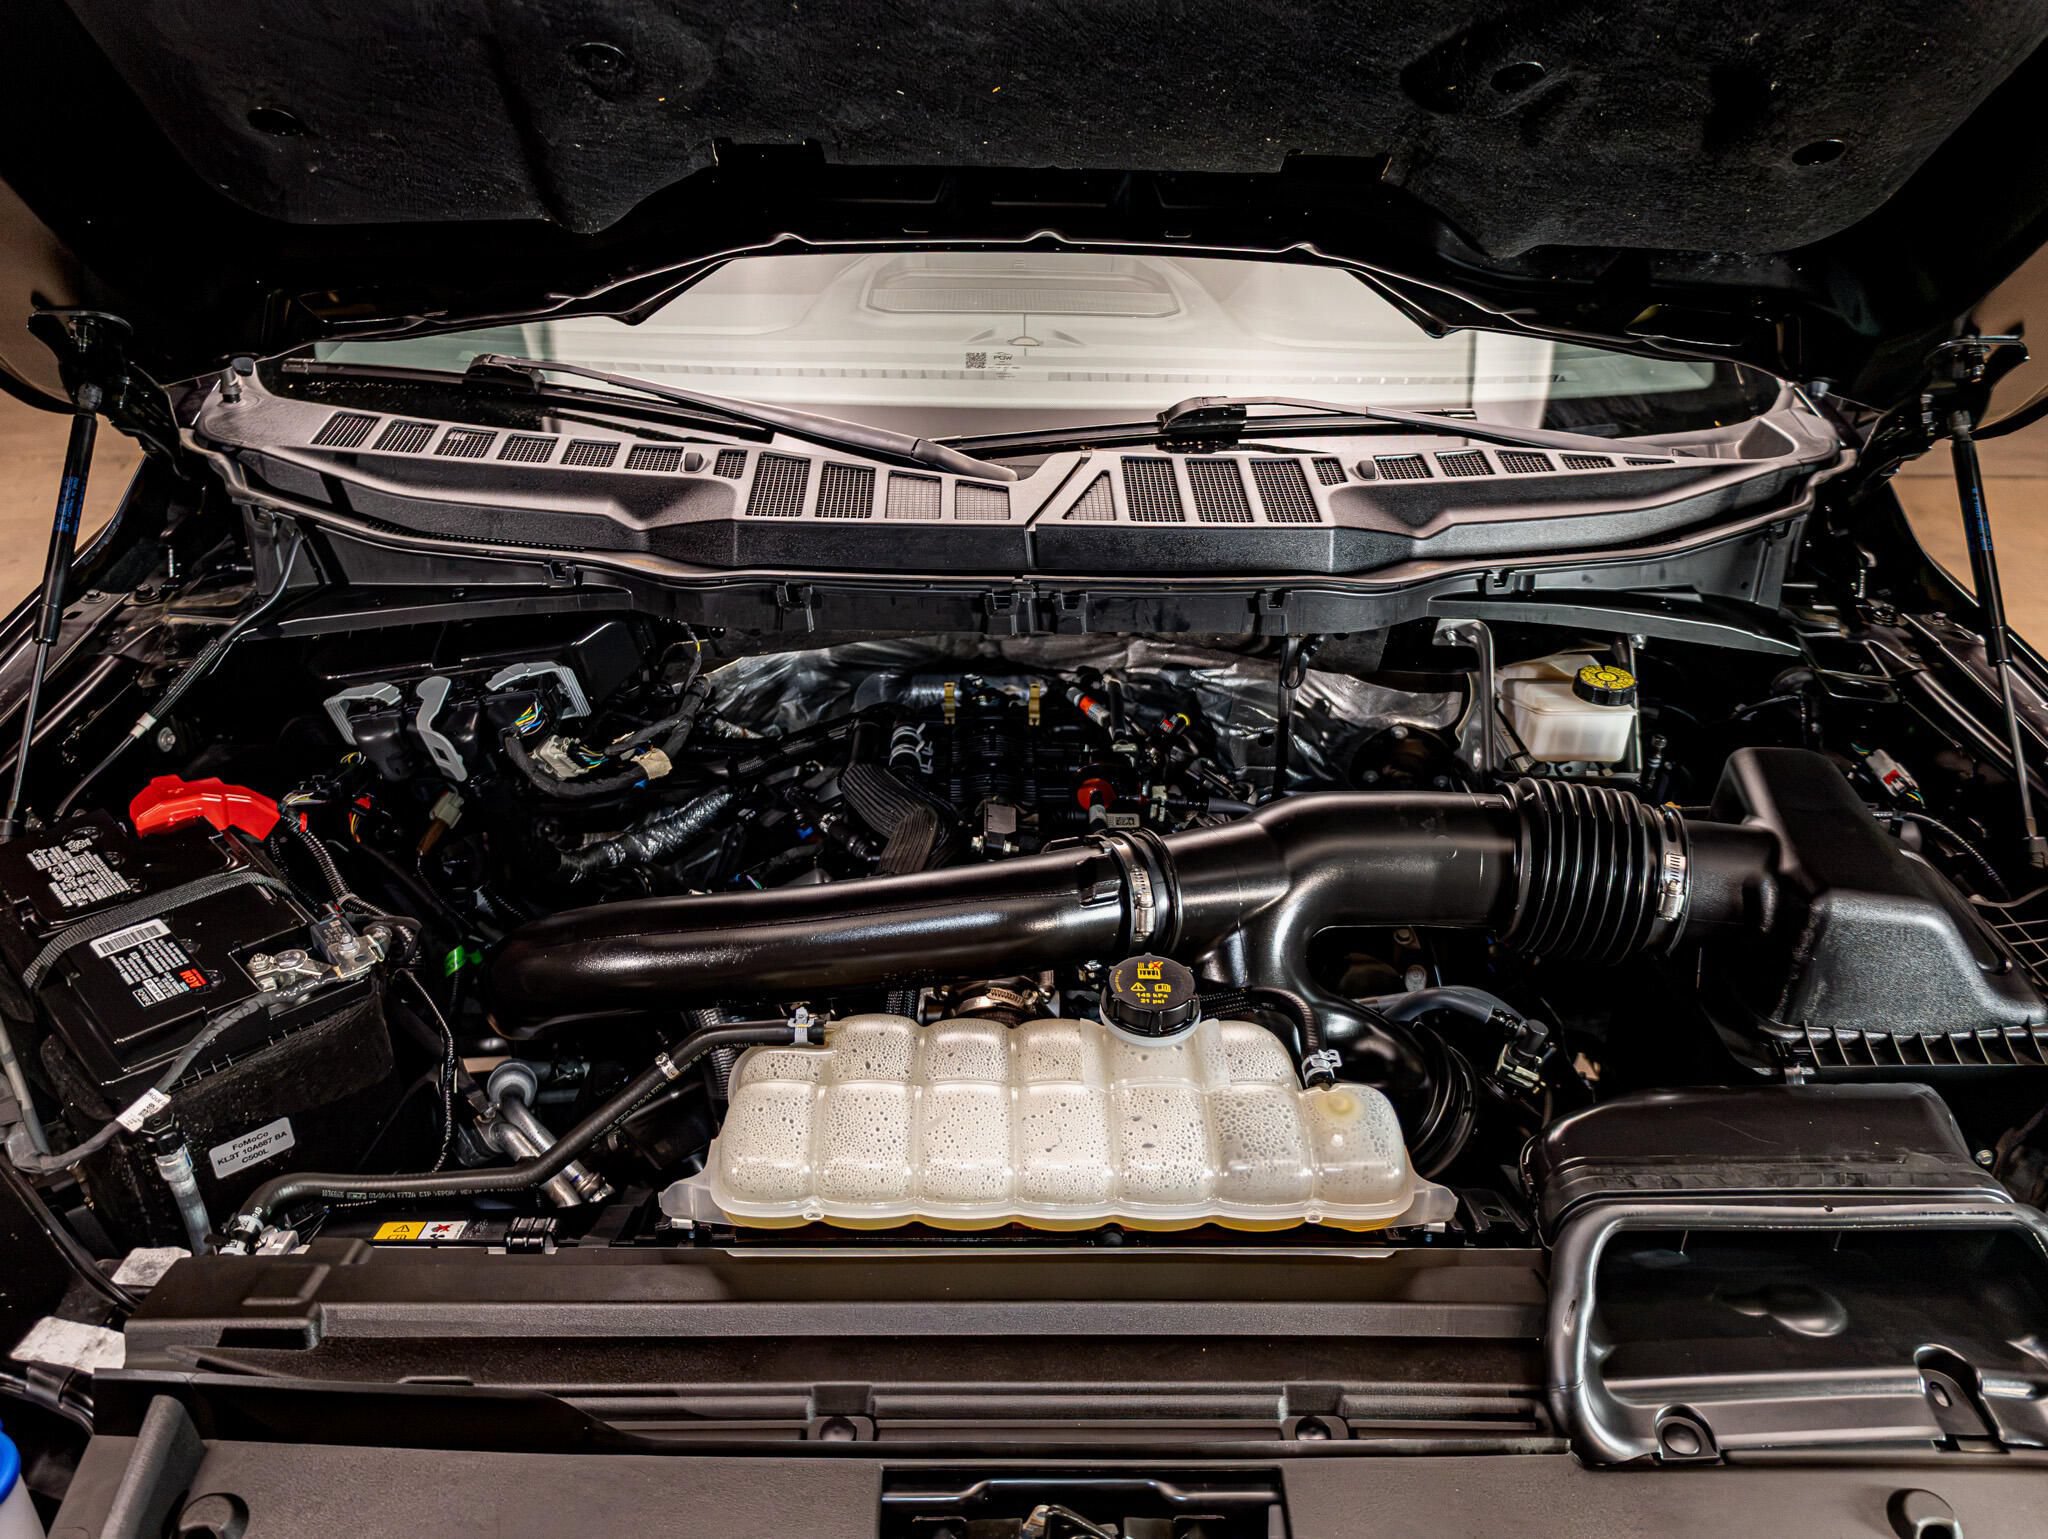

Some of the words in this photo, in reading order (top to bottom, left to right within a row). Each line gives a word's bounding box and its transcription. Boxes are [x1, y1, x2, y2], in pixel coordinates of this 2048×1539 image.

[179, 970, 202, 989] AGM
[217, 1151, 240, 1166] KL3T
[274, 1131, 287, 1141] BA
[232, 1131, 269, 1151] FoMoCo
[241, 1148, 269, 1164] C500L
